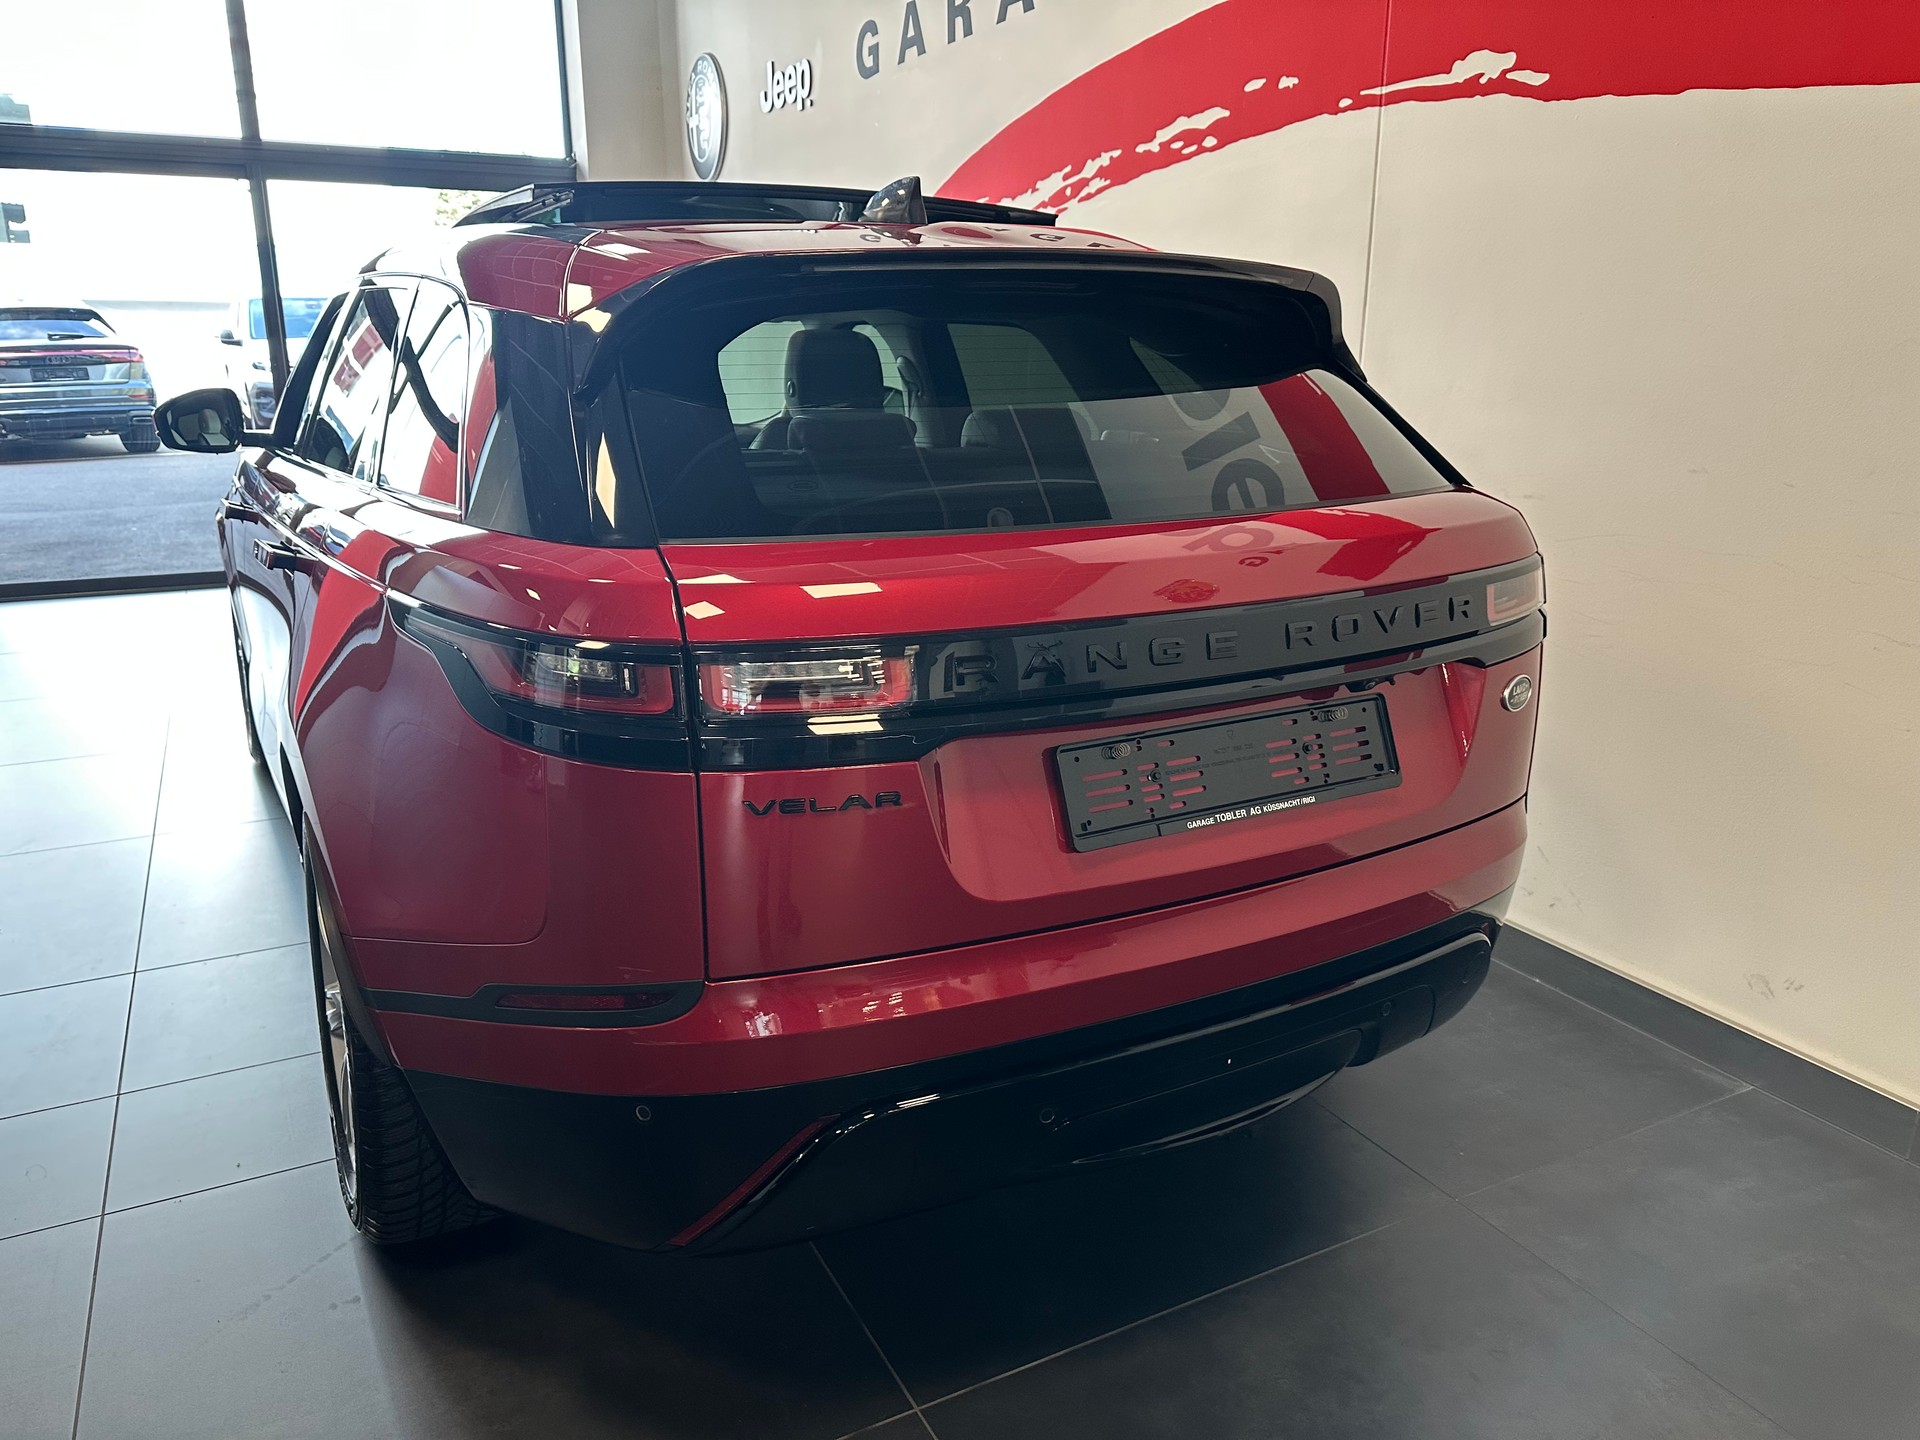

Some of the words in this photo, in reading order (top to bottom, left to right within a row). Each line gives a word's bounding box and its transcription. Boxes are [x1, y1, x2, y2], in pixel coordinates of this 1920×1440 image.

[944, 631, 1238, 690] RANGE
[1285, 595, 1472, 650] ROVER
[743, 791, 903, 816] VELAR
[1187, 817, 1216, 829] GARAGE
[1215, 809, 1248, 823] TOBLER
[1250, 806, 1262, 816] AG
